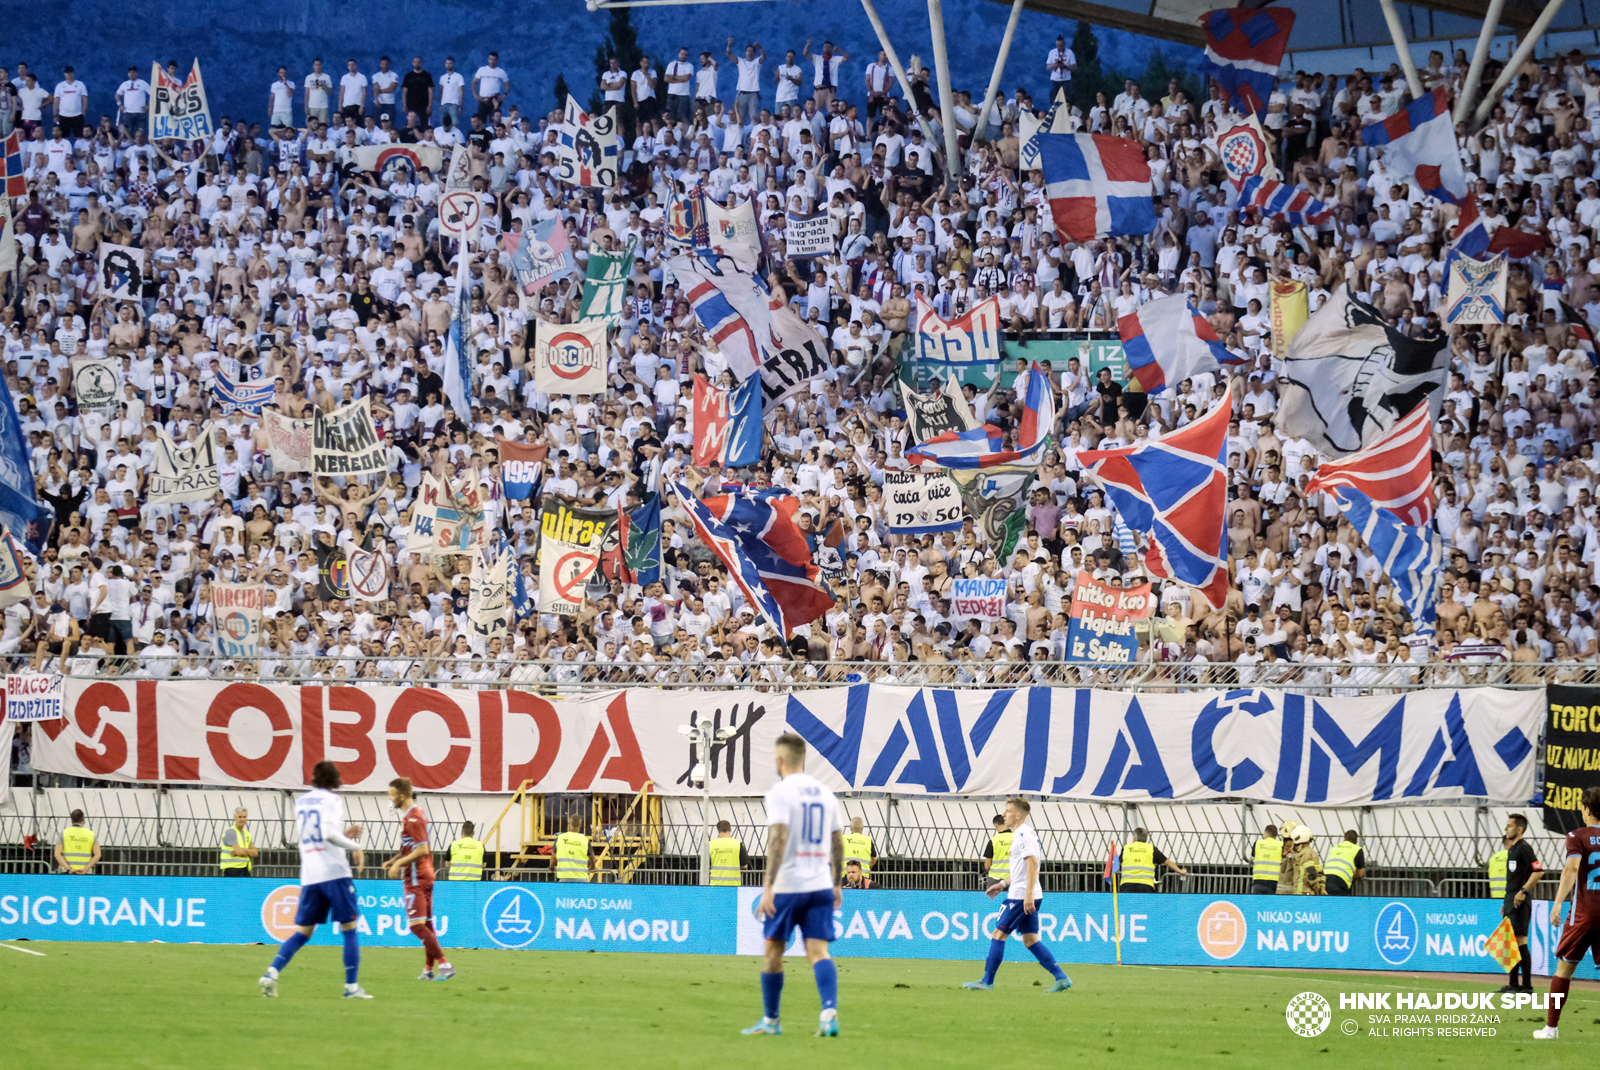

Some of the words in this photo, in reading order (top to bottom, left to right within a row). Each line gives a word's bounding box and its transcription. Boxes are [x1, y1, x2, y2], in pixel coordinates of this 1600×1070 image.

[539, 338, 603, 371] TORCIDA
[911, 365, 969, 382] EXIT
[314, 449, 386, 474] NEREDA
[502, 459, 542, 485] 1950
[150, 469, 219, 494] ULTRAS
[896, 512, 915, 525] 19
[934, 506, 961, 522] 50
[954, 580, 1007, 598] MANDA
[1076, 582, 1115, 608] nitko
[1117, 591, 1146, 610] kao
[955, 596, 1002, 617] IZDRŽI
[1080, 608, 1132, 638] Hajduk
[1072, 635, 1086, 658] iz
[1087, 638, 1131, 662] Splita
[7, 698, 60, 719] IZDRŽITE
[74, 680, 654, 793] SLOBODA
[783, 683, 1488, 803] NAVIJAČIMA
[1547, 744, 1563, 769] UZ
[801, 802, 825, 846] 10
[556, 897, 597, 910] NIKAD
[600, 898, 632, 911] SAMI
[1257, 910, 1292, 924] NIKAD
[1295, 911, 1322, 924] SAMI
[1426, 913, 1454, 925] NIKAD
[1456, 914, 1478, 926] SAMI
[555, 917, 594, 940] NA
[603, 919, 690, 943] MORU
[1256, 930, 1287, 951] NA
[1291, 931, 1349, 953] PUTU
[1426, 933, 1455, 955] NA
